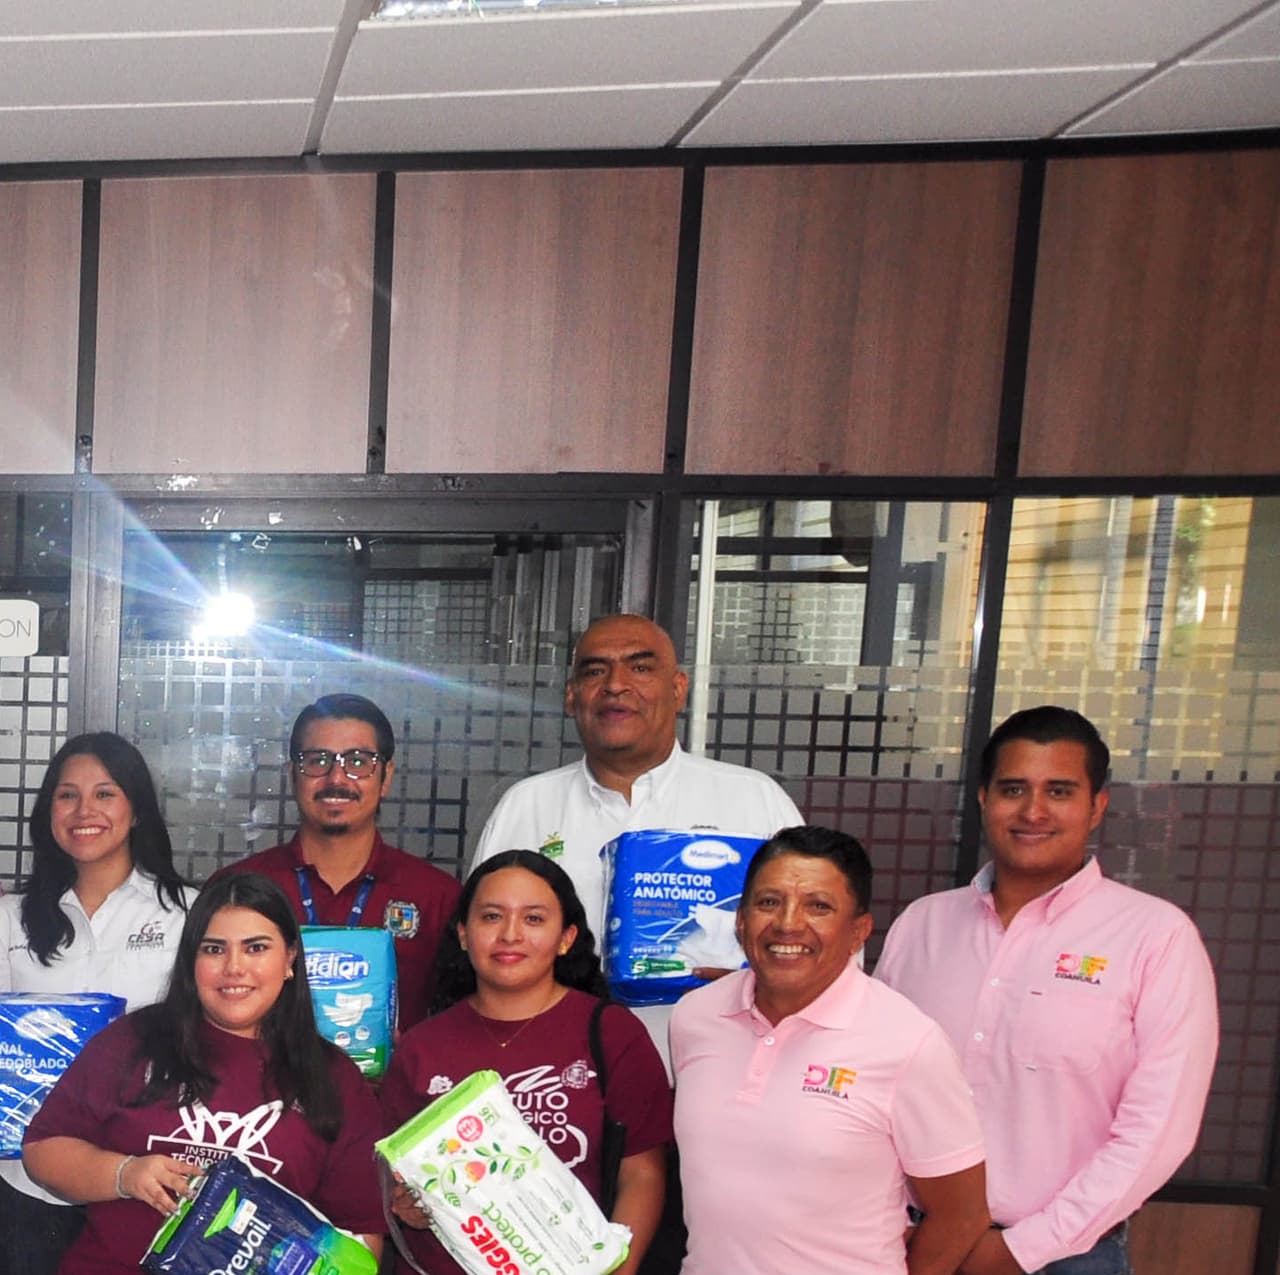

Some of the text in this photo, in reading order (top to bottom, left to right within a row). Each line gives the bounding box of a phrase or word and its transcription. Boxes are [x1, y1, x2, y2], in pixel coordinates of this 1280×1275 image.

[634, 872, 712, 887] PROTECTOR
[633, 886, 716, 902] ANATÓMICO
[1056, 953, 1109, 977] DIF
[803, 1064, 857, 1091] DIF
[479, 1201, 542, 1268] protect
